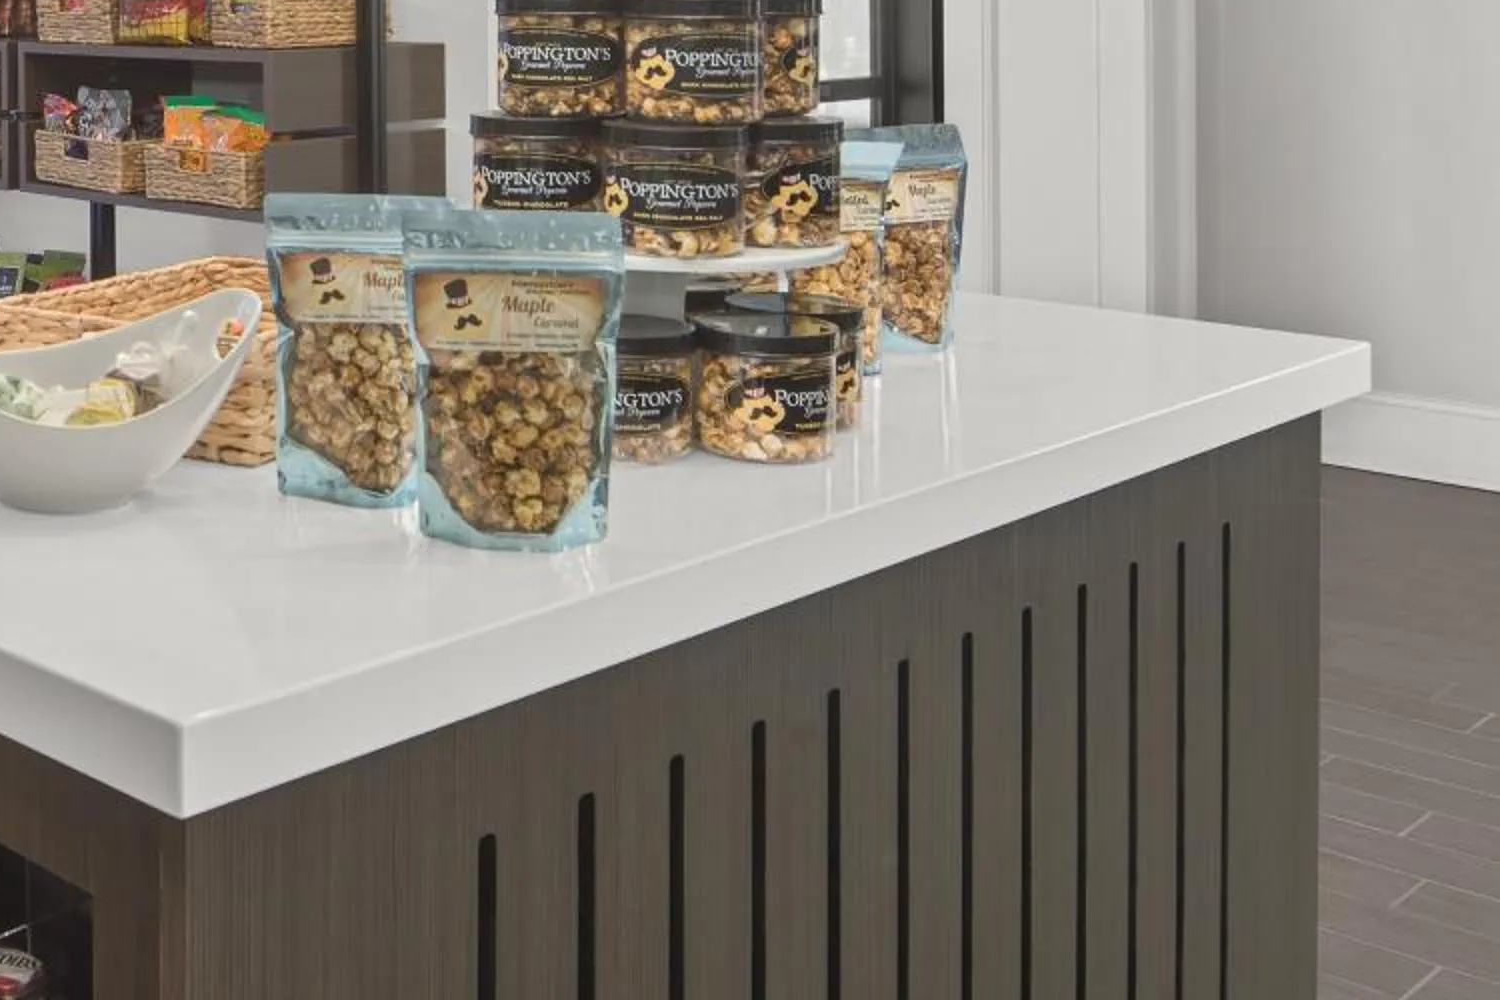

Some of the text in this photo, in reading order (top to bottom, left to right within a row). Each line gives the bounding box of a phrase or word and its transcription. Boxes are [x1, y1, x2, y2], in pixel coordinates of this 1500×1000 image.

[503, 42, 611, 62] POPPINGTON'S
[481, 165, 591, 186] POPPINGTON'S
[620, 177, 739, 199] POPPINGTON'S
[501, 295, 556, 317] Maple
